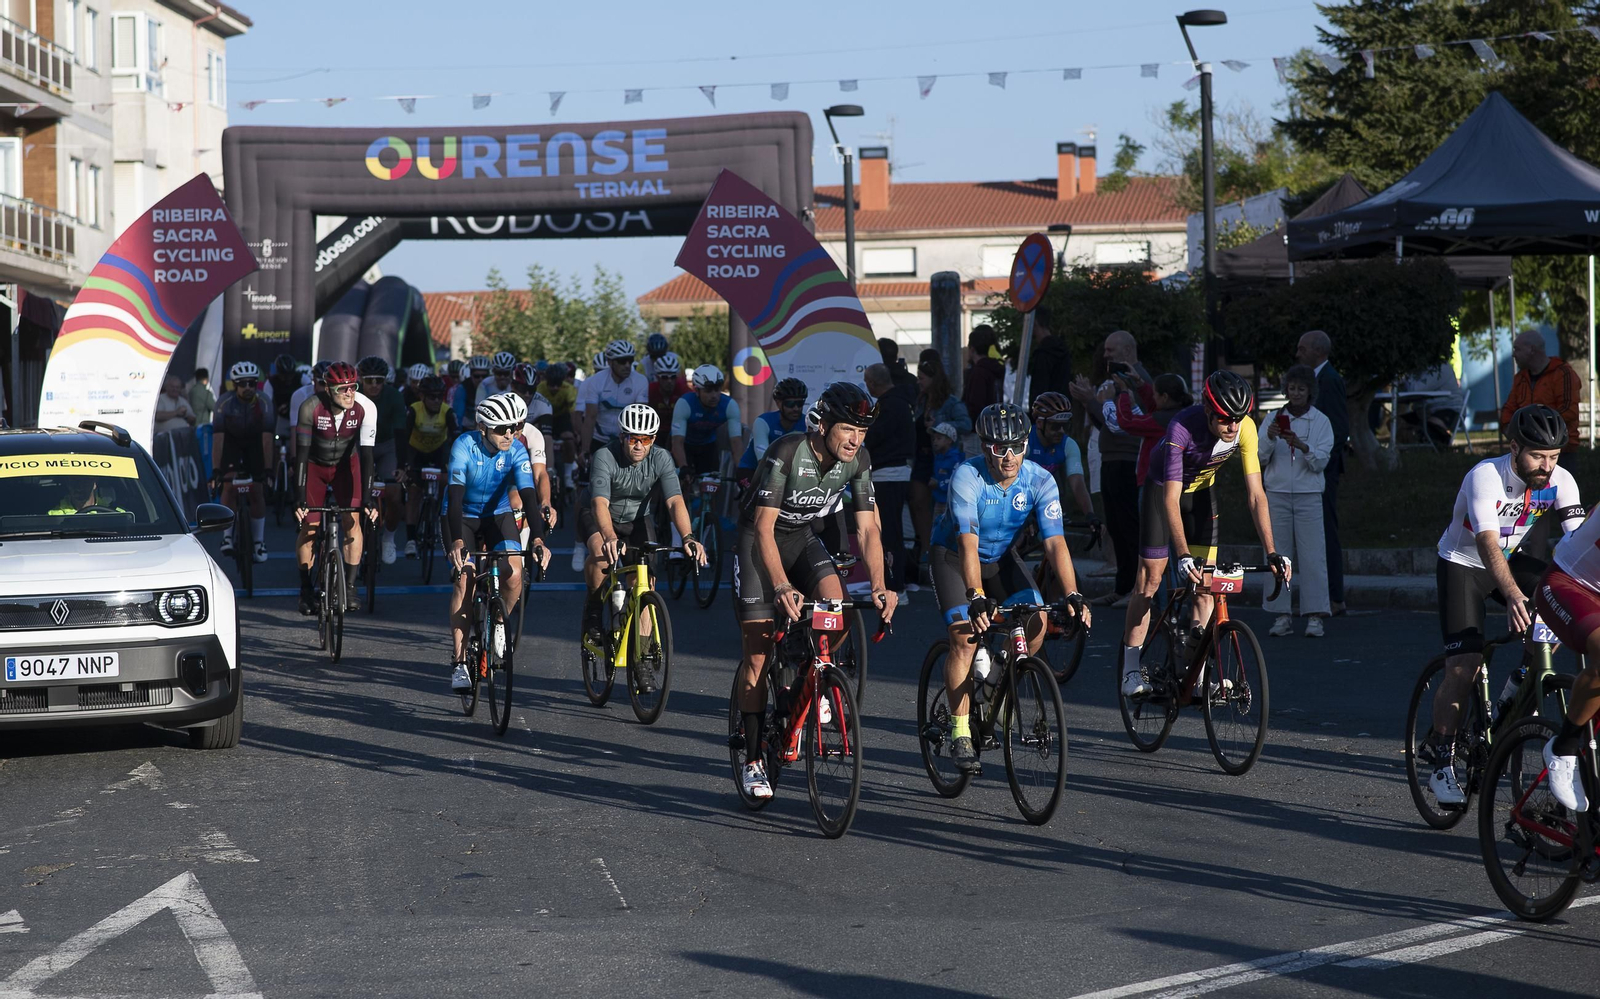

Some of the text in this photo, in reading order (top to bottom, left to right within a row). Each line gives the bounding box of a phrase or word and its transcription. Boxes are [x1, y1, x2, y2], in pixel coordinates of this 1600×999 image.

[365, 128, 669, 181] OURENSE
[574, 179, 671, 199] TERMAL
[152, 207, 227, 223] RIBEIRA
[706, 205, 780, 219] RIBEIRA
[152, 228, 218, 243] SACRA
[706, 225, 770, 239] SACRA
[153, 248, 234, 263] CYCLING
[706, 245, 786, 259] CYCLING
[154, 268, 208, 283] ROAD
[707, 264, 760, 278] ROAD
[0, 459, 112, 470] ICIO MÉDICO
[425, 473, 438, 481] 170
[237, 486, 250, 494] 102
[705, 484, 718, 493] 187
[1220, 582, 1235, 592] 78
[823, 617, 837, 629] 51
[20, 658, 70, 677] 9047
[77, 655, 114, 675] NNP
[1519, 724, 1540, 738] SWISS
